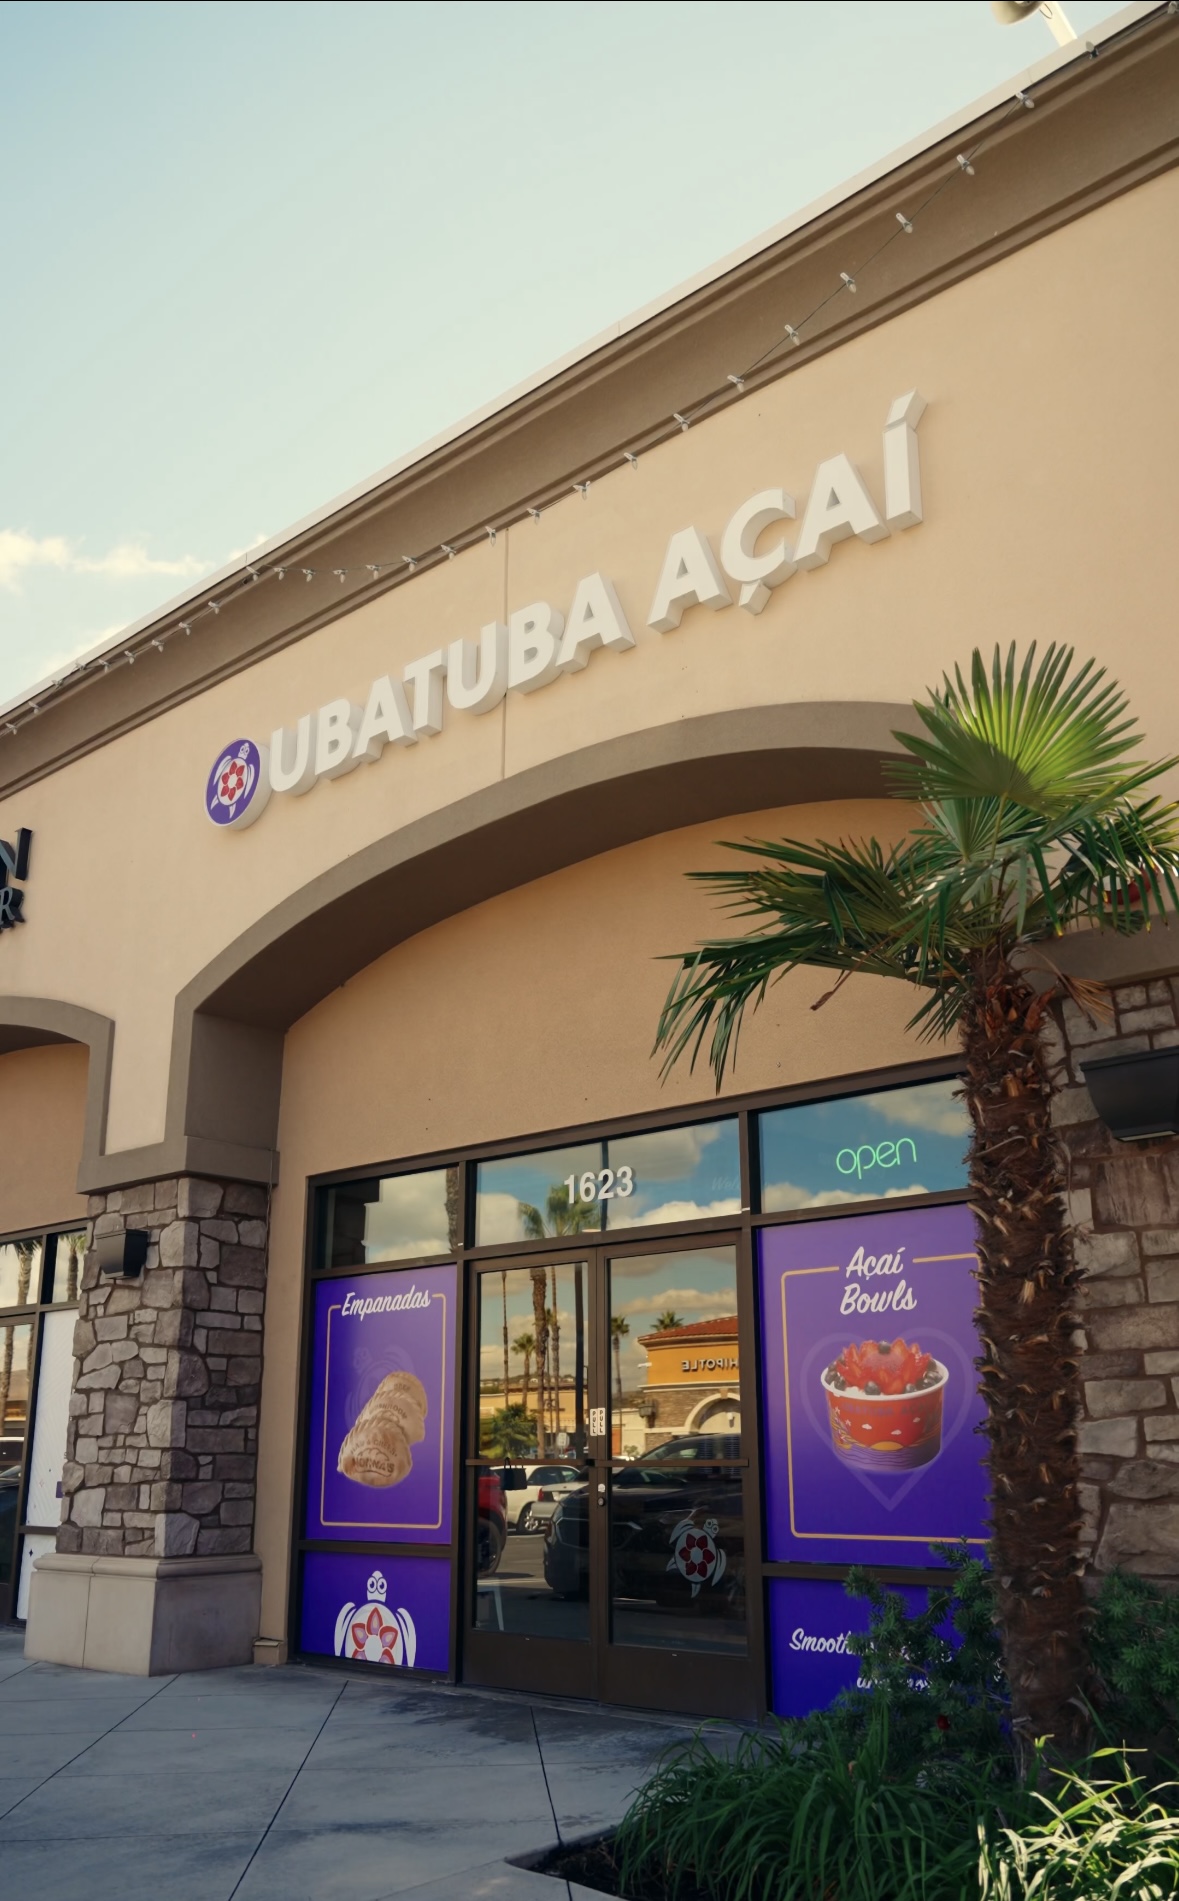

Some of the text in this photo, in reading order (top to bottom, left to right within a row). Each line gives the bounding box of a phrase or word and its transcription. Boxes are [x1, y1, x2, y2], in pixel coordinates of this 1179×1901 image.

[268, 387, 928, 797] UBATUBA AÇAÍ
[836, 1137, 917, 1180] open
[563, 1165, 634, 1204] 1623
[845, 1246, 906, 1281] Açaí
[341, 1284, 431, 1321] Empanadas
[840, 1279, 918, 1315] Bowls
